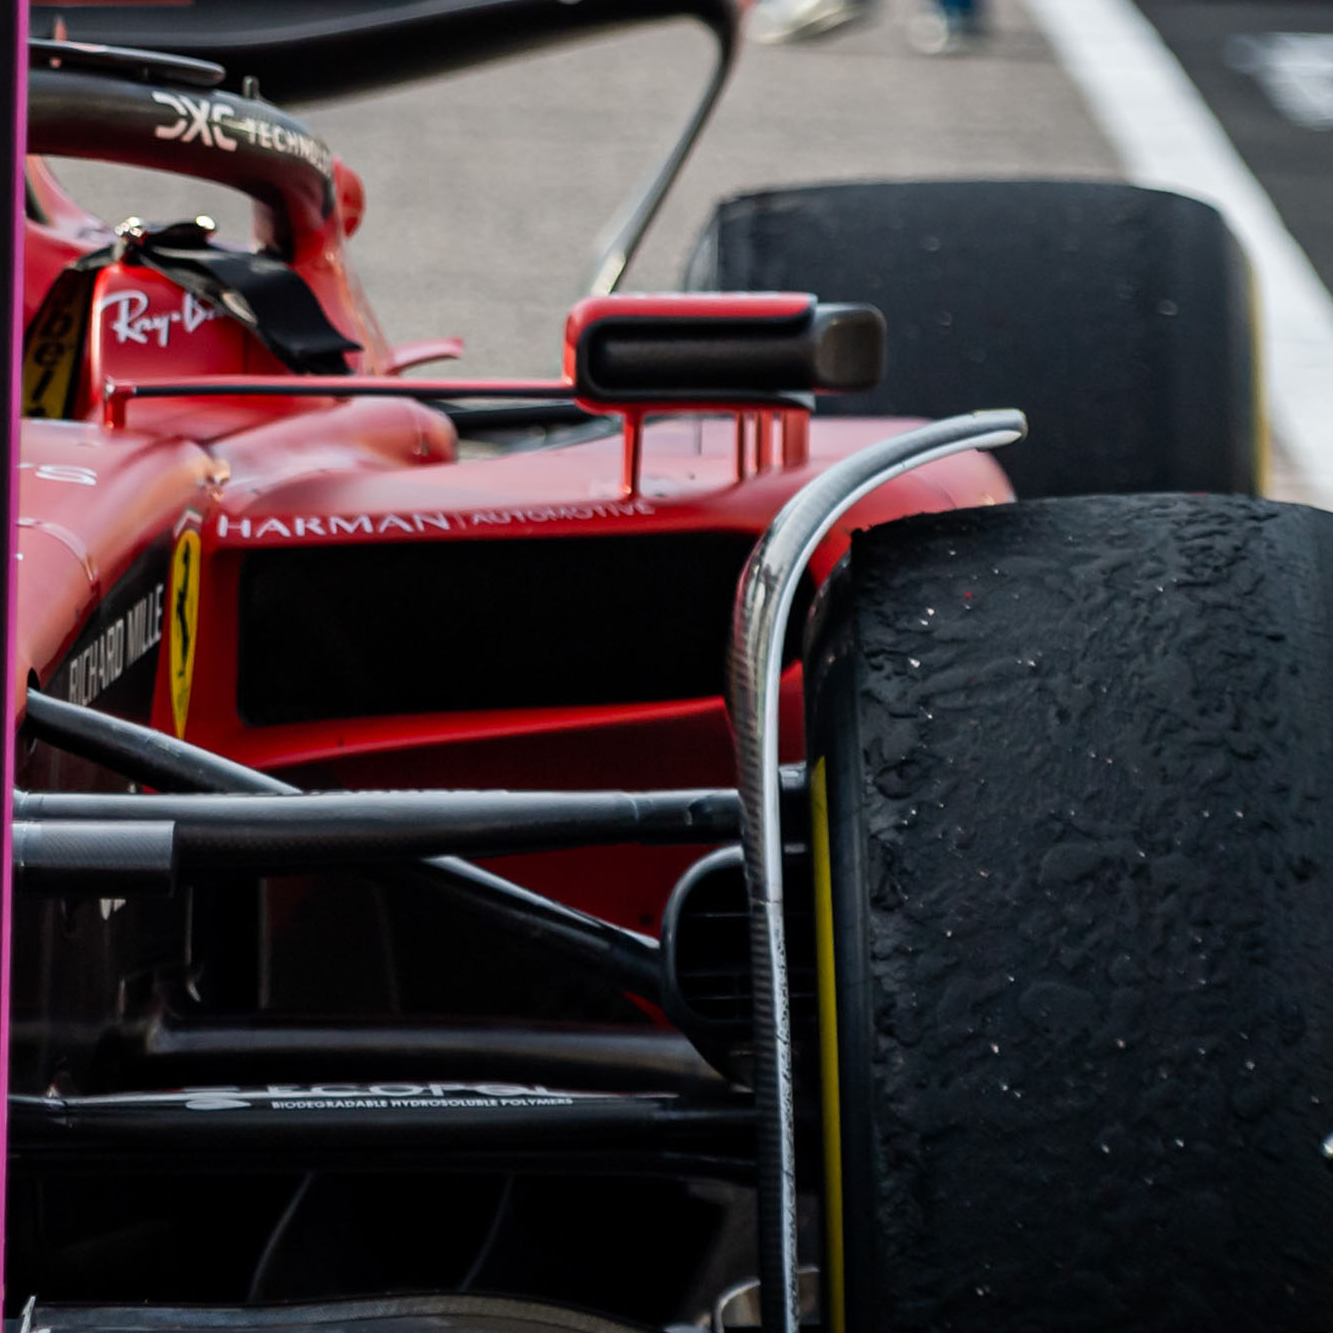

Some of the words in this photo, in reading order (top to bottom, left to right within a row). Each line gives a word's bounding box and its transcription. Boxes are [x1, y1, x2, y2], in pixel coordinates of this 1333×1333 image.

[217, 512, 450, 539] HARMAN
[271, 1098, 388, 1111] BIODEGRADABLE
[390, 1098, 499, 1110] HYDROSOLUBLE
